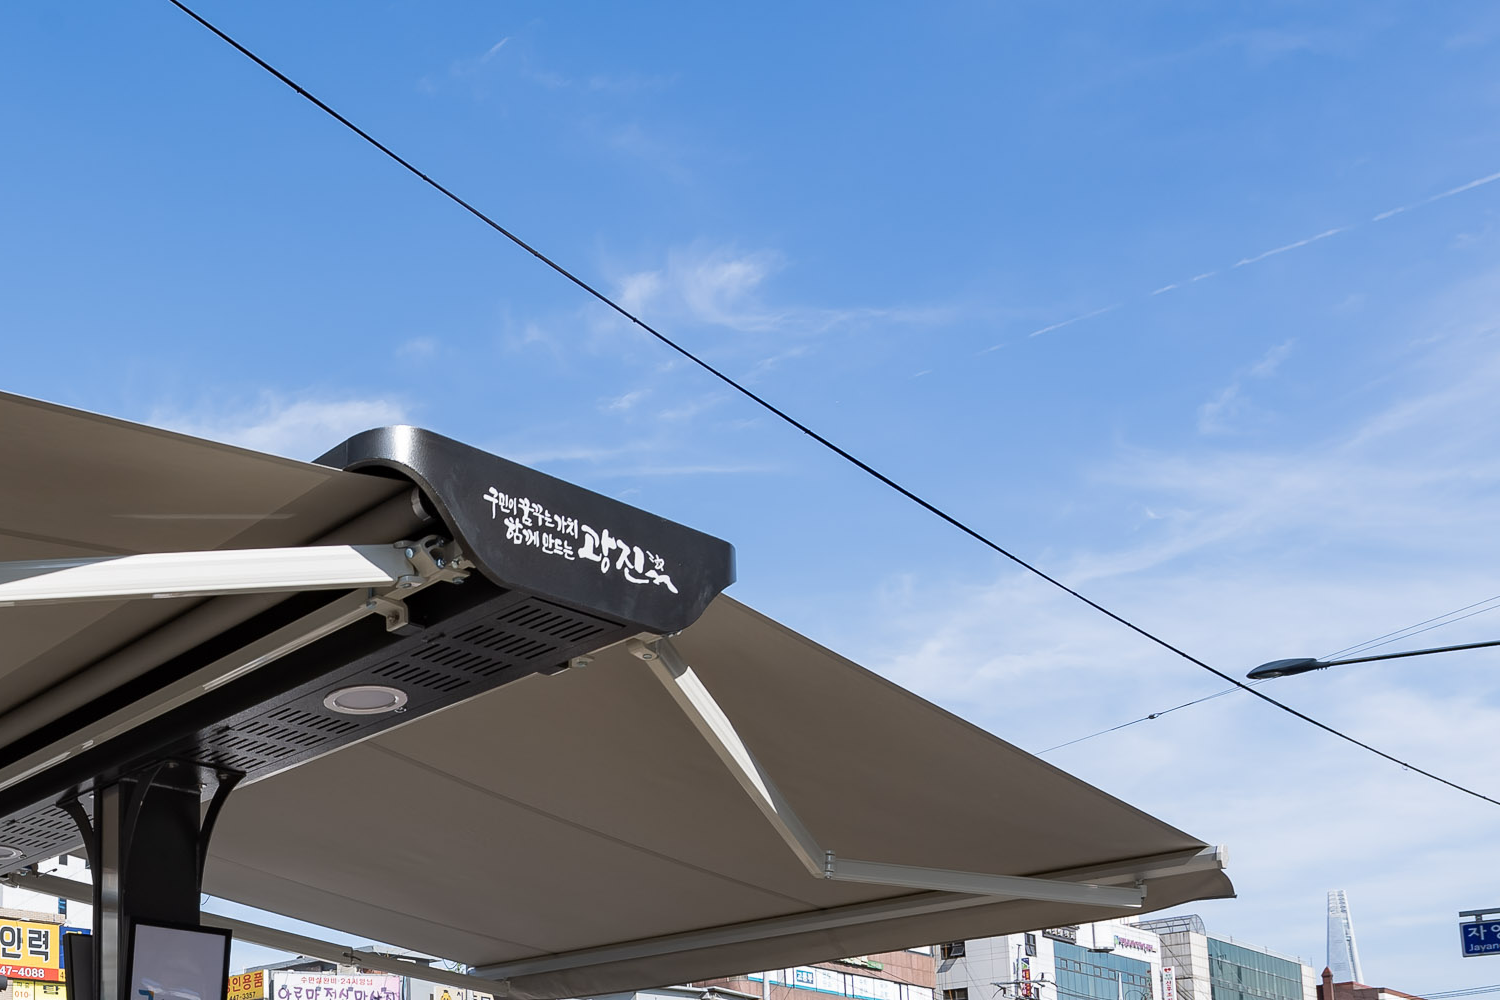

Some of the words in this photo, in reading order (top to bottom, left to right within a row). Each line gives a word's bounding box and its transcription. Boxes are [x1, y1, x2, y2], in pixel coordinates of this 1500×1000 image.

[504, 518, 540, 548] 함께
[541, 532, 575, 561] 만드는
[553, 513, 579, 539] 가치
